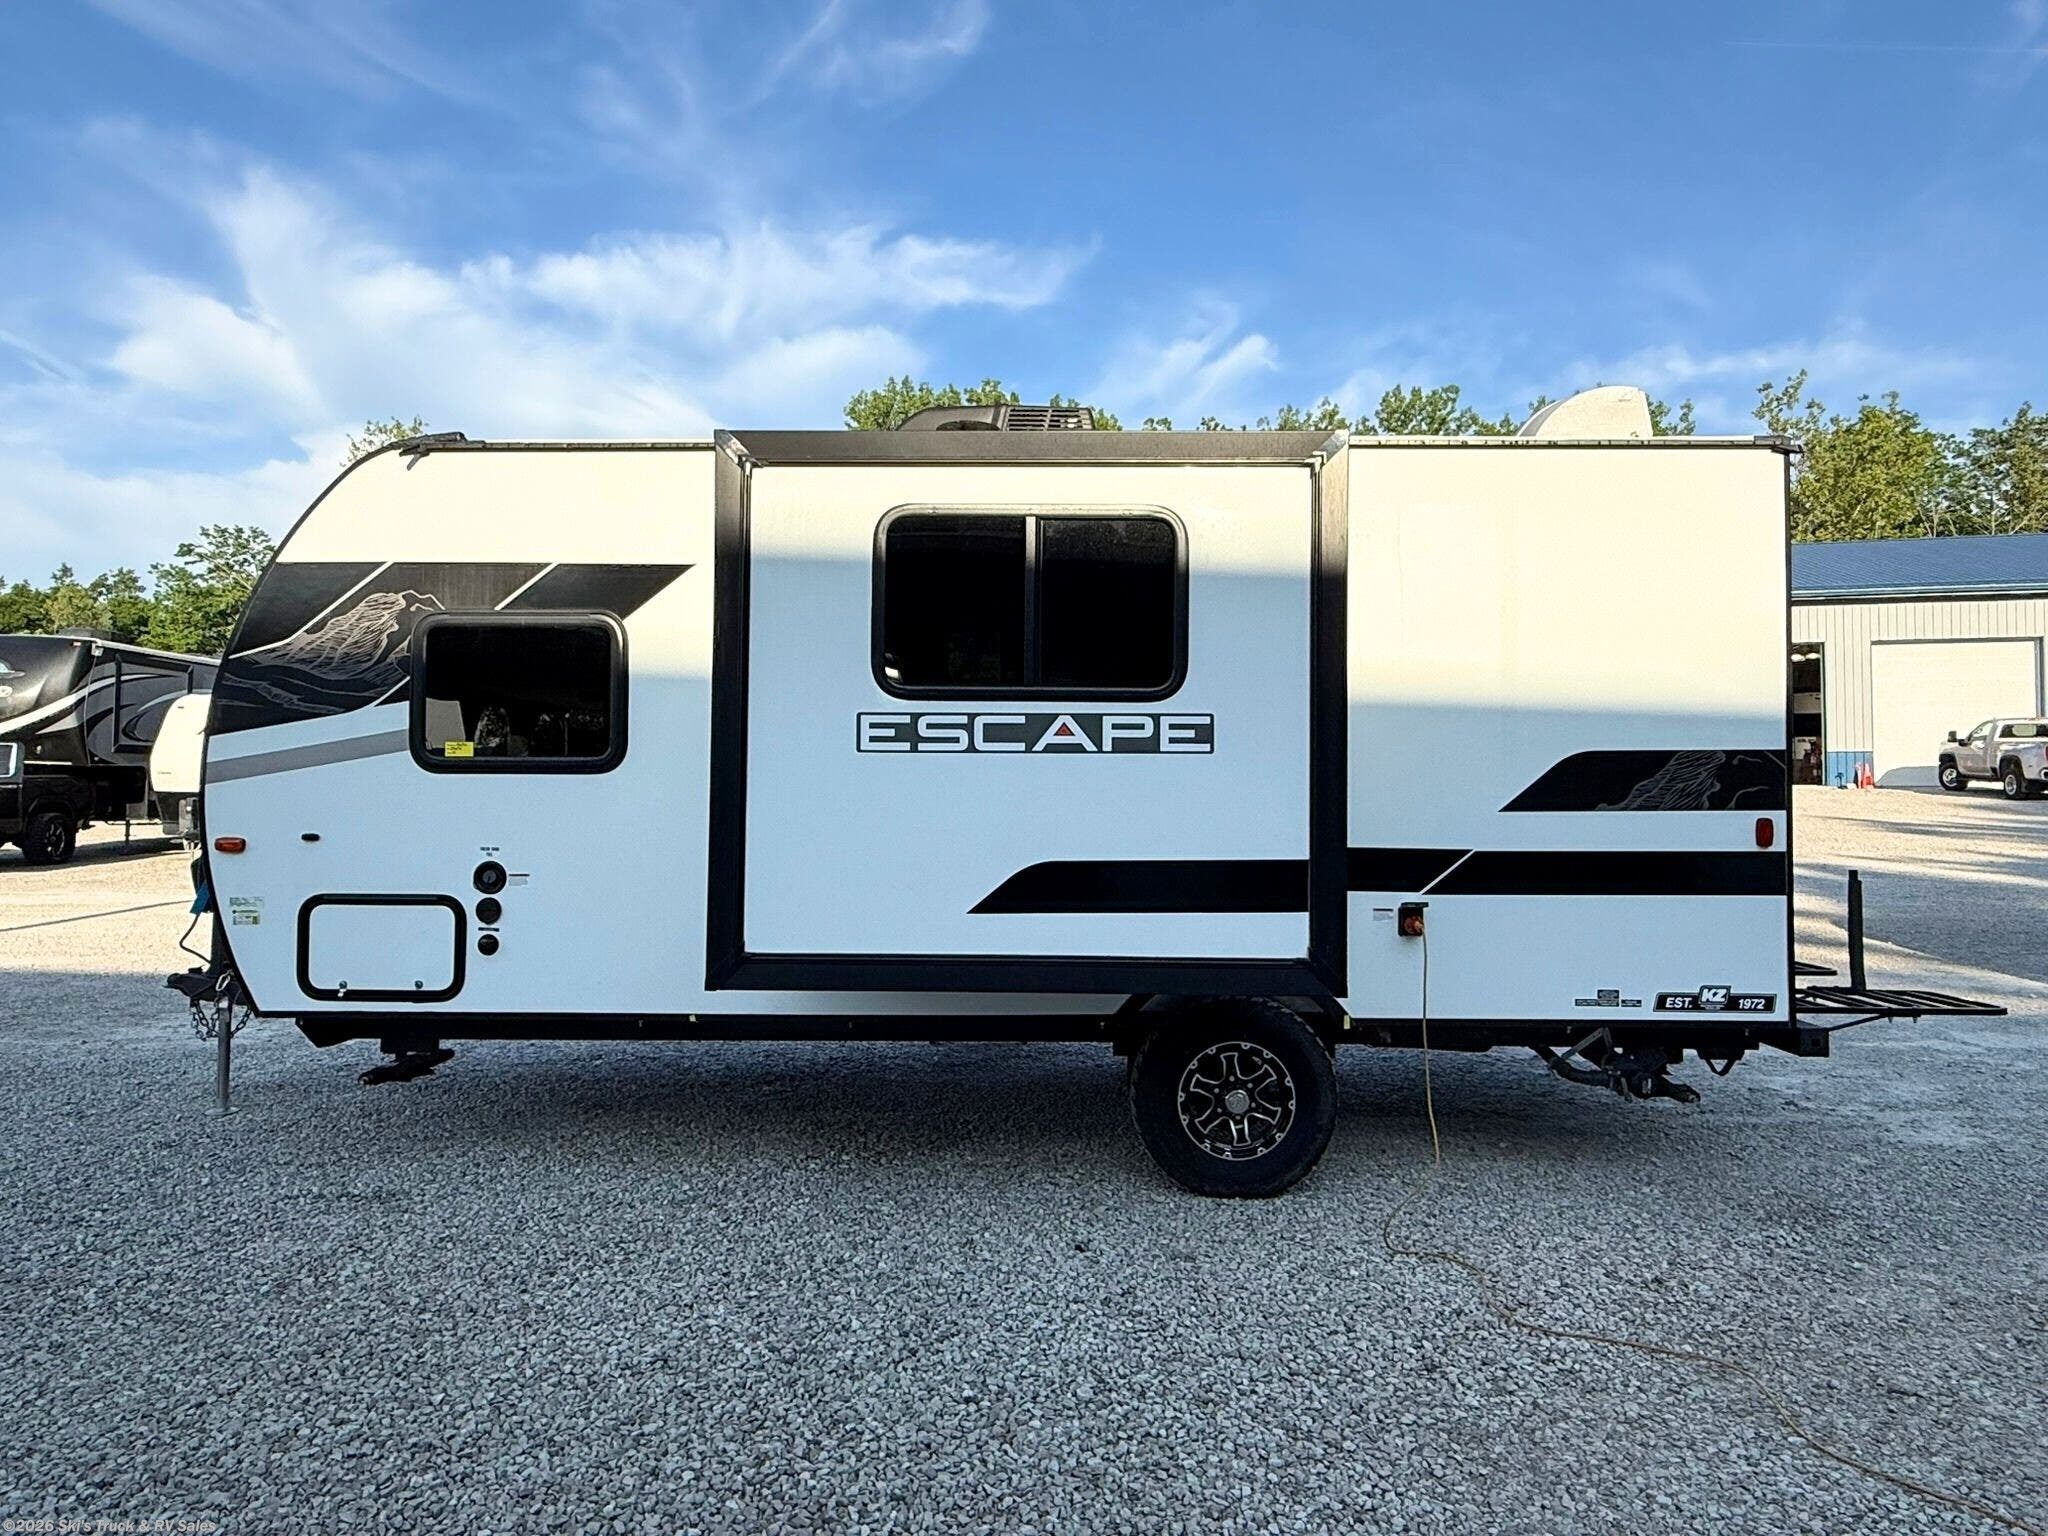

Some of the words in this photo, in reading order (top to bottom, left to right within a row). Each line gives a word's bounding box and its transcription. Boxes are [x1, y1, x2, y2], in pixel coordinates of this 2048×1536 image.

[858, 713, 1213, 753] ESCAPE
[1665, 997, 1693, 1009] EST.
[1701, 988, 1728, 1002] KZ
[1738, 998, 1766, 1010] 1972
